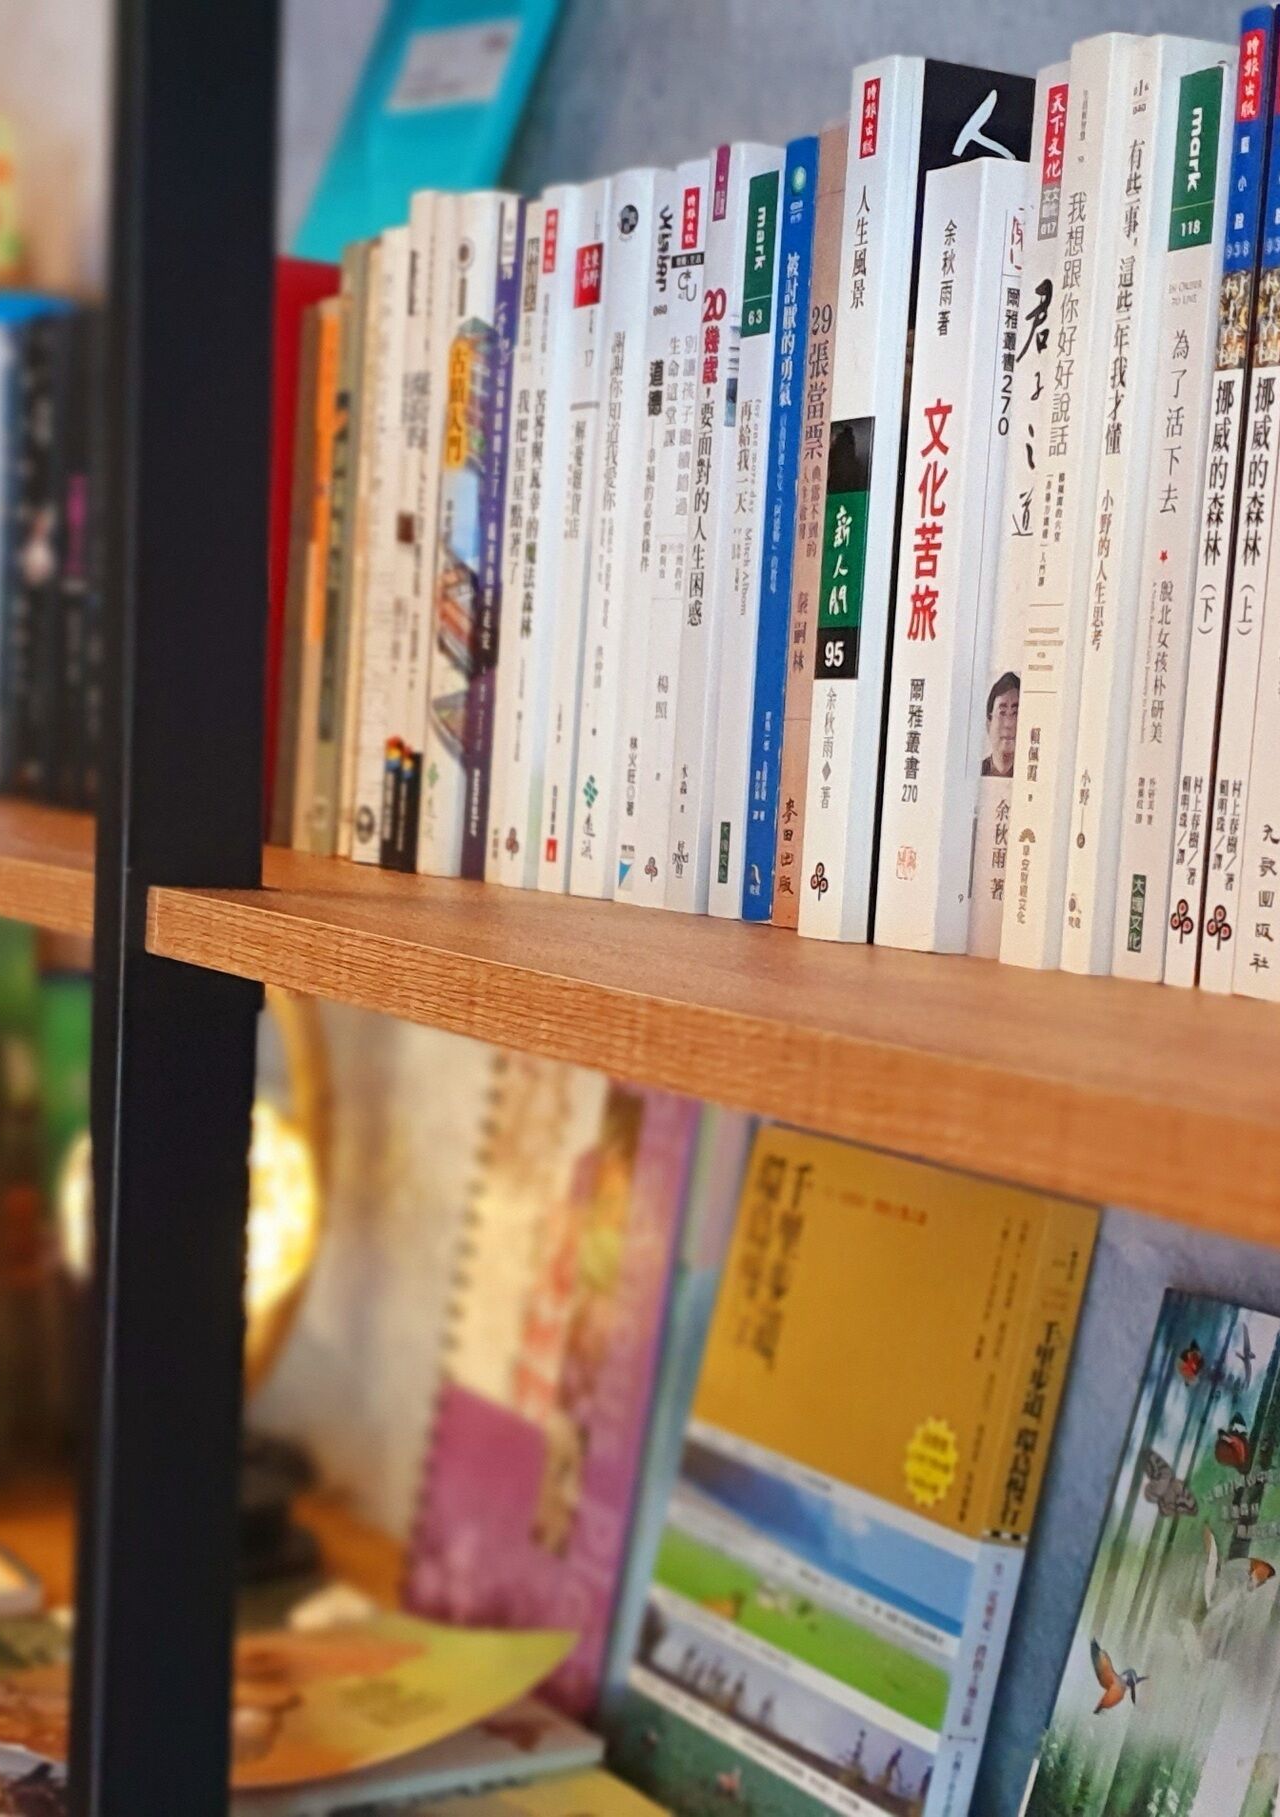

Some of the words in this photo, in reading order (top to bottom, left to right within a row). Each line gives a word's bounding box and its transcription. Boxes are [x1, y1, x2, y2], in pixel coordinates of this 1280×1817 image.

[861, 83, 877, 155] 時報出版
[1240, 37, 1260, 119] 時報出版
[1044, 93, 1066, 179] 天下文化
[1186, 106, 1204, 193] mark
[753, 206, 767, 271] mark
[850, 184, 871, 309] 人生風景
[1039, 221, 1058, 237] 017
[1180, 220, 1201, 237] 118
[747, 309, 763, 325] 63
[937, 219, 958, 337] 余秋雨著
[1104, 138, 1146, 456] 有些事，這些年我才懂
[778, 252, 801, 409] 被討厭的勇氣
[1048, 191, 1087, 458] 我想跟你好好說話
[646, 360, 665, 416] 道德
[803, 303, 833, 460] 29張當票
[1158, 330, 1191, 515] 為了活下去
[733, 399, 752, 514] 再給我一天
[907, 398, 954, 641] 文化苦旅
[1090, 489, 1115, 651] 小野的人生思考
[654, 674, 669, 720] 楊照
[824, 641, 845, 667] 95
[1149, 580, 1174, 745] 脫北女孩朴研美
[1079, 768, 1092, 806] 小野
[776, 797, 798, 895] 麥田出版
[992, 798, 1011, 870] 余秋雨
